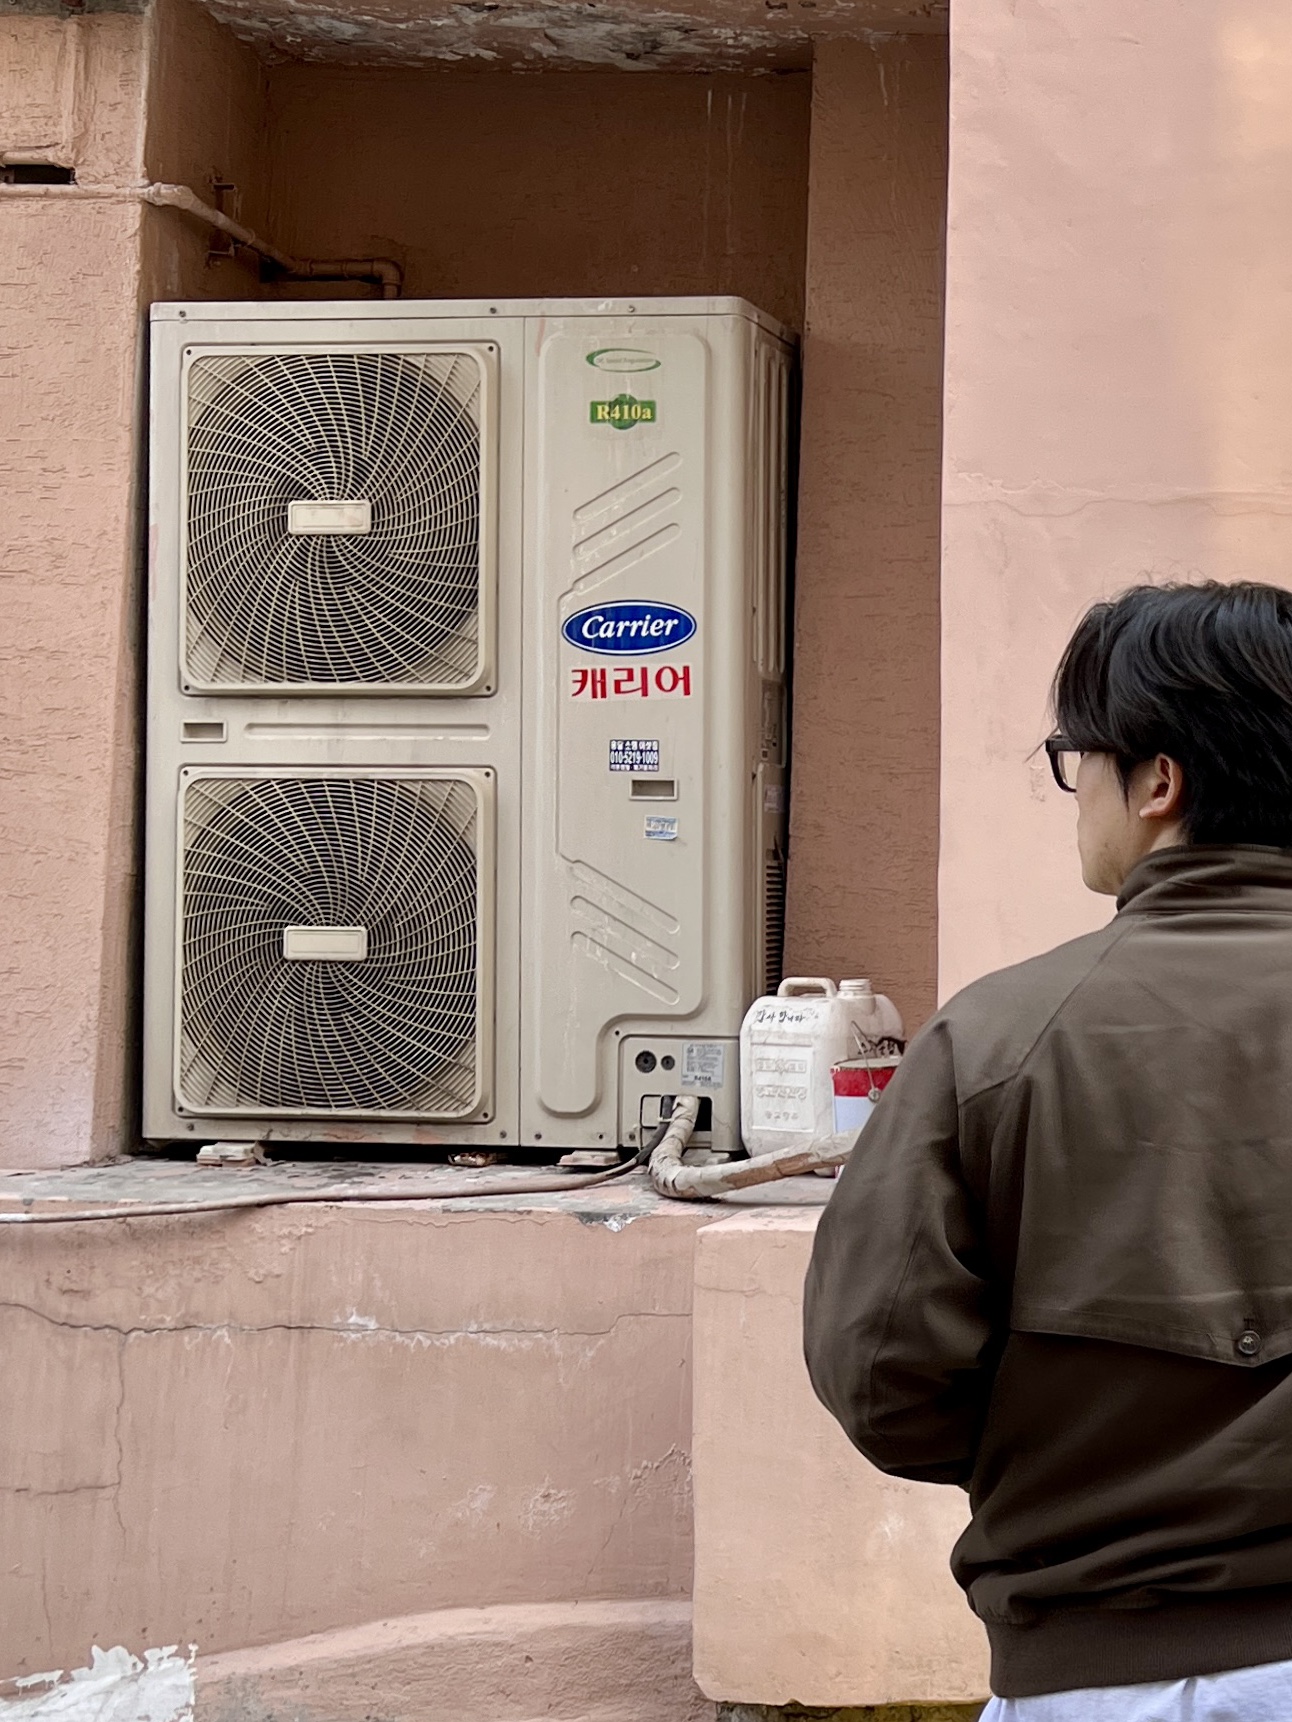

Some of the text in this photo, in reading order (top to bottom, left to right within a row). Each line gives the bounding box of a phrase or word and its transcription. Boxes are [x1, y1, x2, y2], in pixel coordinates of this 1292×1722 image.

[596, 404, 652, 420] R410a
[581, 614, 680, 639] Carrier
[571, 665, 691, 699] 캐리어
[610, 751, 658, 764] 010-5219-1009
